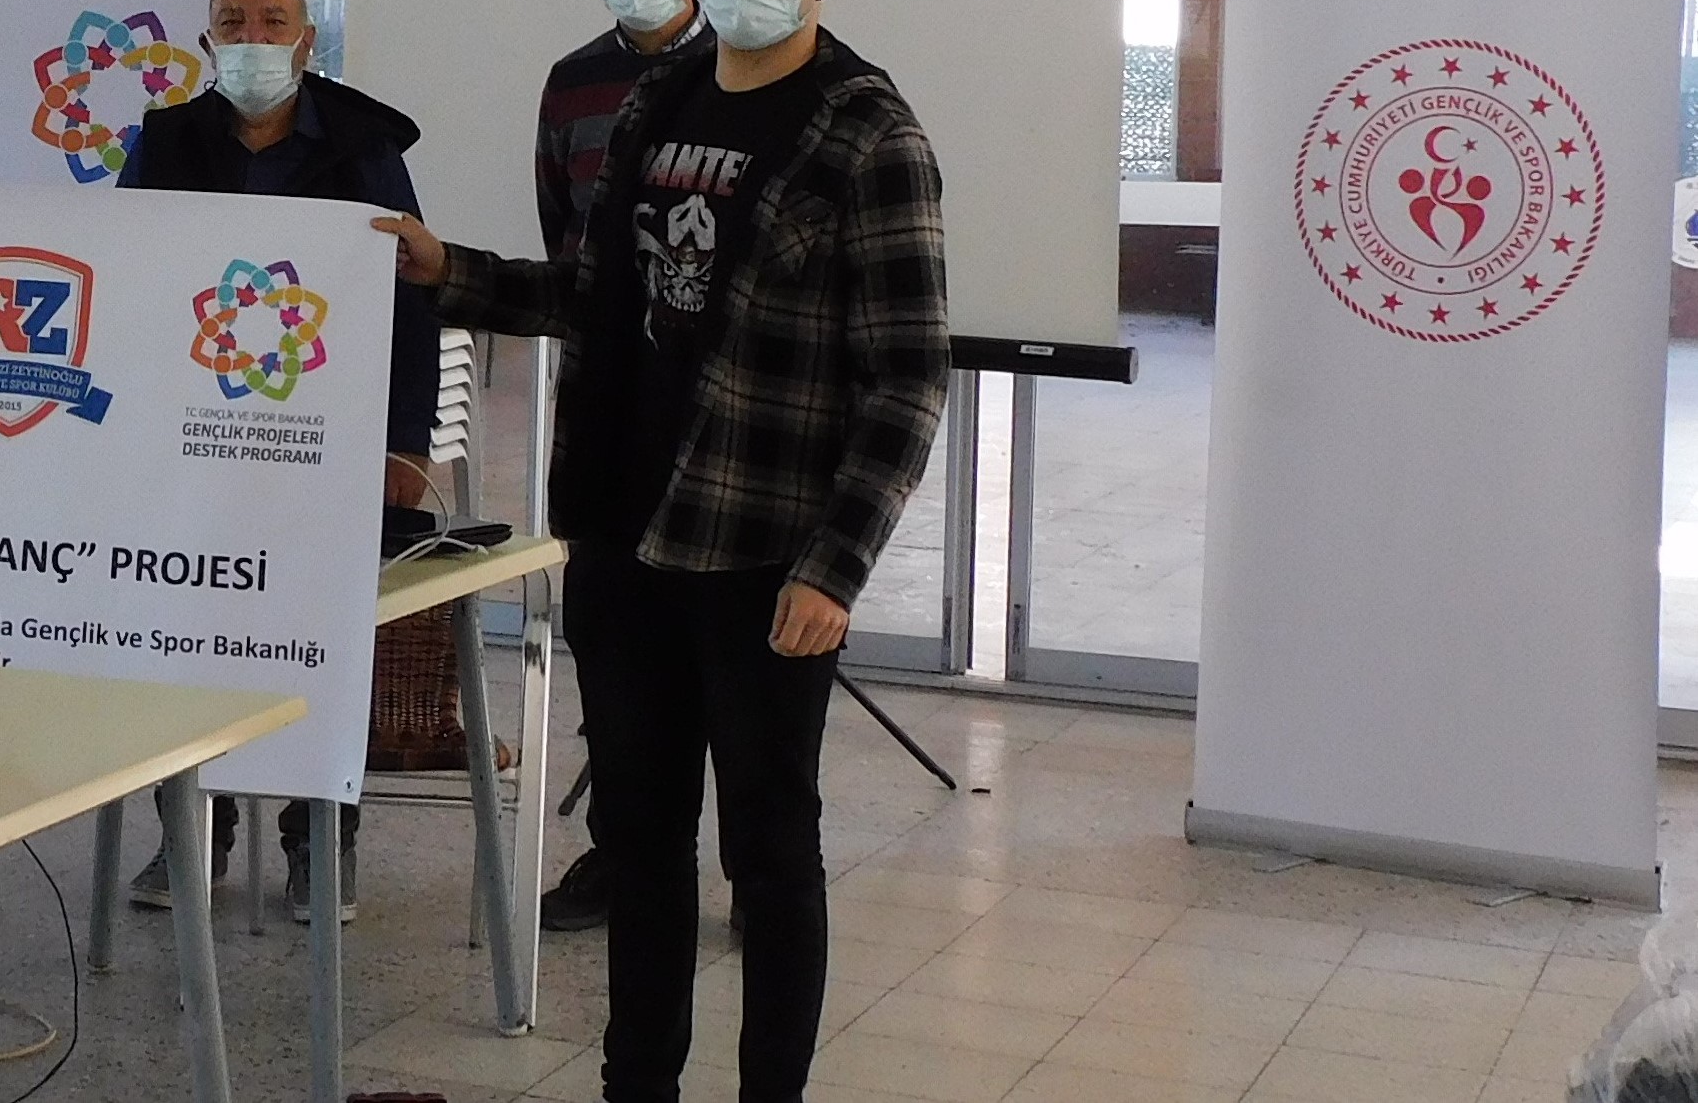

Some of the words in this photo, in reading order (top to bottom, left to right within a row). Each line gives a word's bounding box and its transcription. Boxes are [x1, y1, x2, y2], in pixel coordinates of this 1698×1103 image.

[1421, 95, 1504, 125] GENÇLİK
[1504, 121, 1525, 144] VE
[1347, 100, 1417, 214] CUMHURİYETİ
[1520, 146, 1545, 196] SPOR
[1353, 219, 1417, 282] TÜRKİYE
[1468, 202, 1543, 284] BAKANLIĞI
[9, 379, 39, 391] SPOR
[39, 382, 80, 398] KULÜBÜ
[11, 364, 83, 386] ZEYTİNOĞLU
[238, 410, 249, 422] VE
[252, 411, 276, 424] SPOR
[182, 422, 243, 442] GENÇLİK
[246, 427, 325, 446] PROJELERİ
[182, 442, 238, 459] DESTEK
[240, 447, 322, 465] PROGRAMI
[110, 546, 268, 592] PROJESİ
[21, 617, 109, 647] Gençlik
[115, 628, 143, 649] ve
[149, 628, 206, 656] Spor
[213, 634, 326, 668] Bakanlığı
